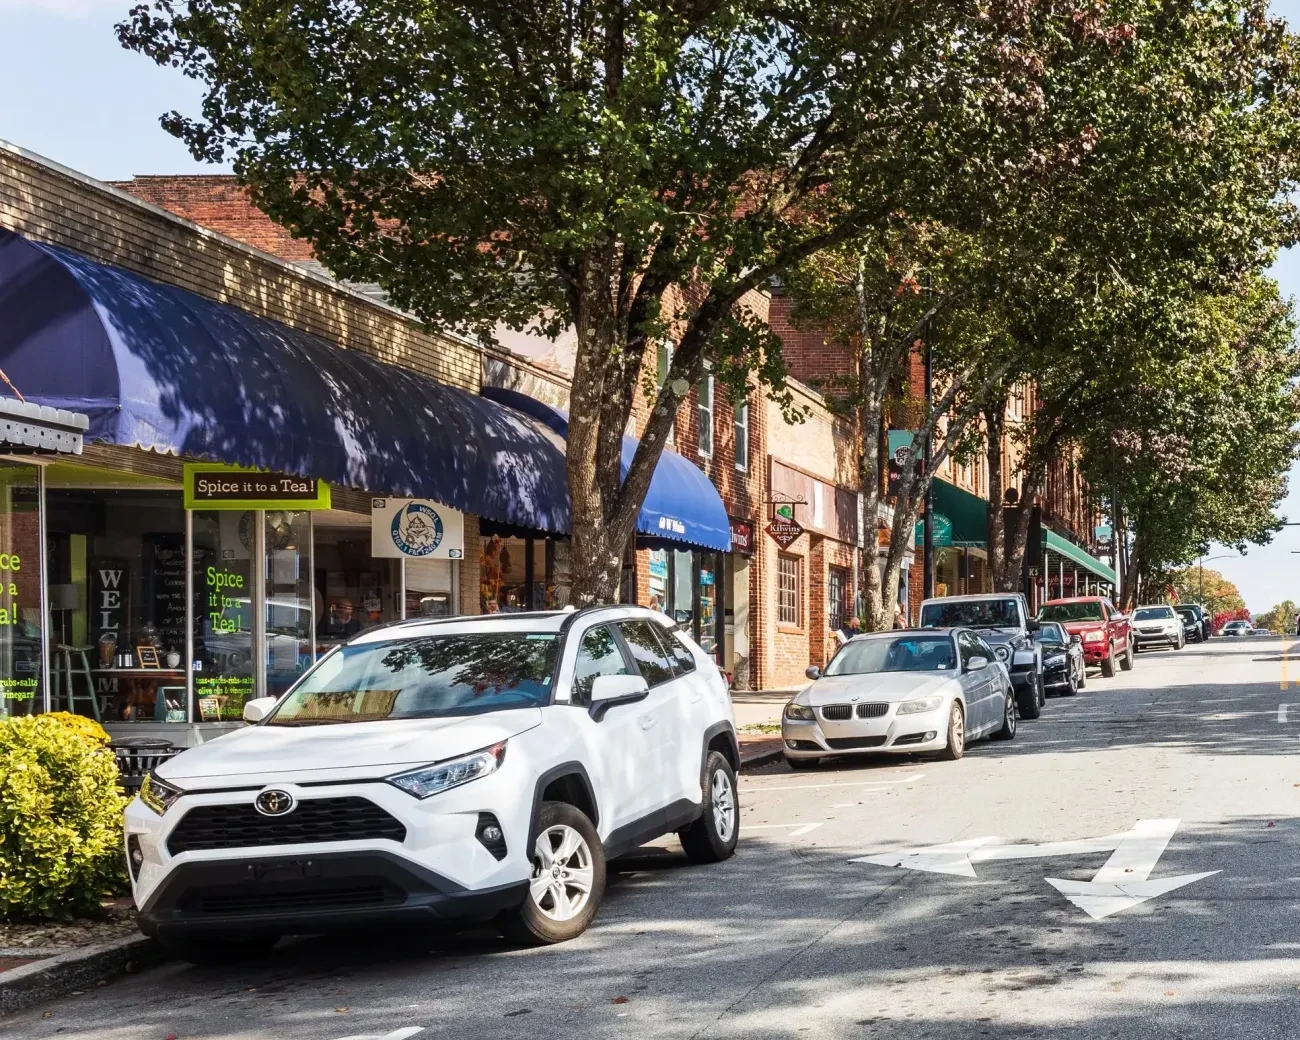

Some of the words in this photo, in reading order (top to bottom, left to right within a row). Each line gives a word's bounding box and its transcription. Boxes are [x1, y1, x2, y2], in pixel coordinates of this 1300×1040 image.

[198, 479, 239, 496] Spice
[243, 482, 252, 492] it
[255, 482, 267, 492] to
[270, 484, 278, 492] a
[280, 479, 315, 492] Tea!
[419, 506, 440, 523] WSQL
[729, 525, 748, 547] lwins
[770, 524, 800, 533] Kilwins
[206, 566, 243, 592] Spice
[8, 582, 18, 595] a
[209, 592, 217, 607] it
[221, 594, 232, 608] to
[235, 598, 241, 608] a
[0, 602, 18, 625] a!
[209, 612, 241, 632] Tea!
[97, 569, 123, 714] WELME
[2, 690, 35, 701] vinegars
